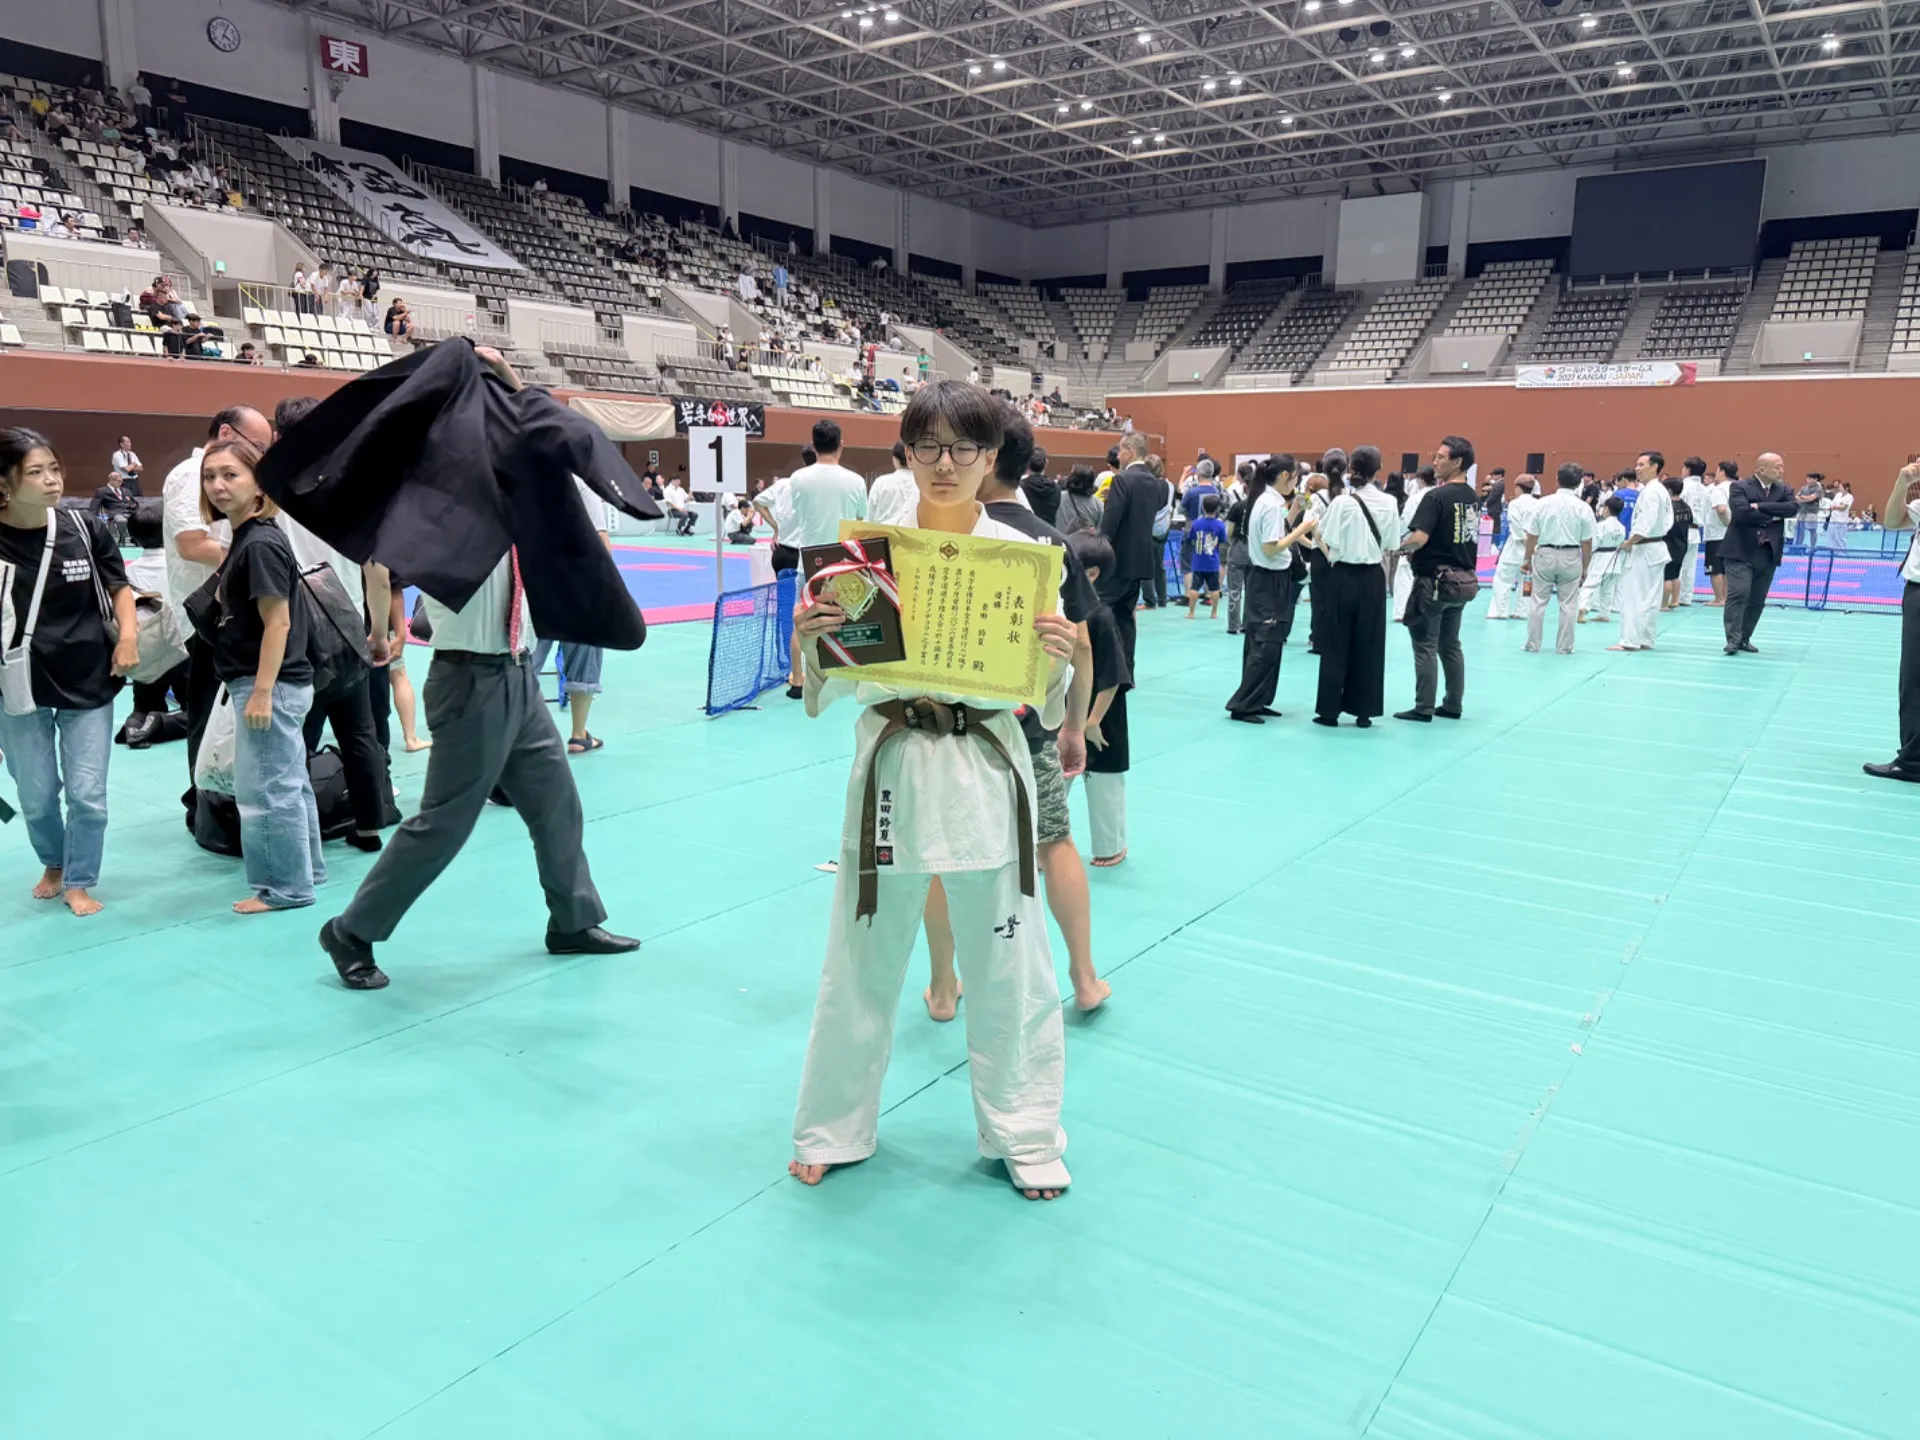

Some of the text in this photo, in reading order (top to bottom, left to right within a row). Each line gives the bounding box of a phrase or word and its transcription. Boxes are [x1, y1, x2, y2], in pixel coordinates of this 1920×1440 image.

[327, 39, 361, 75] 東
[679, 401, 761, 428] 岩手から世界へ
[708, 435, 723, 482] 1
[1007, 594, 1024, 644] 表彰状
